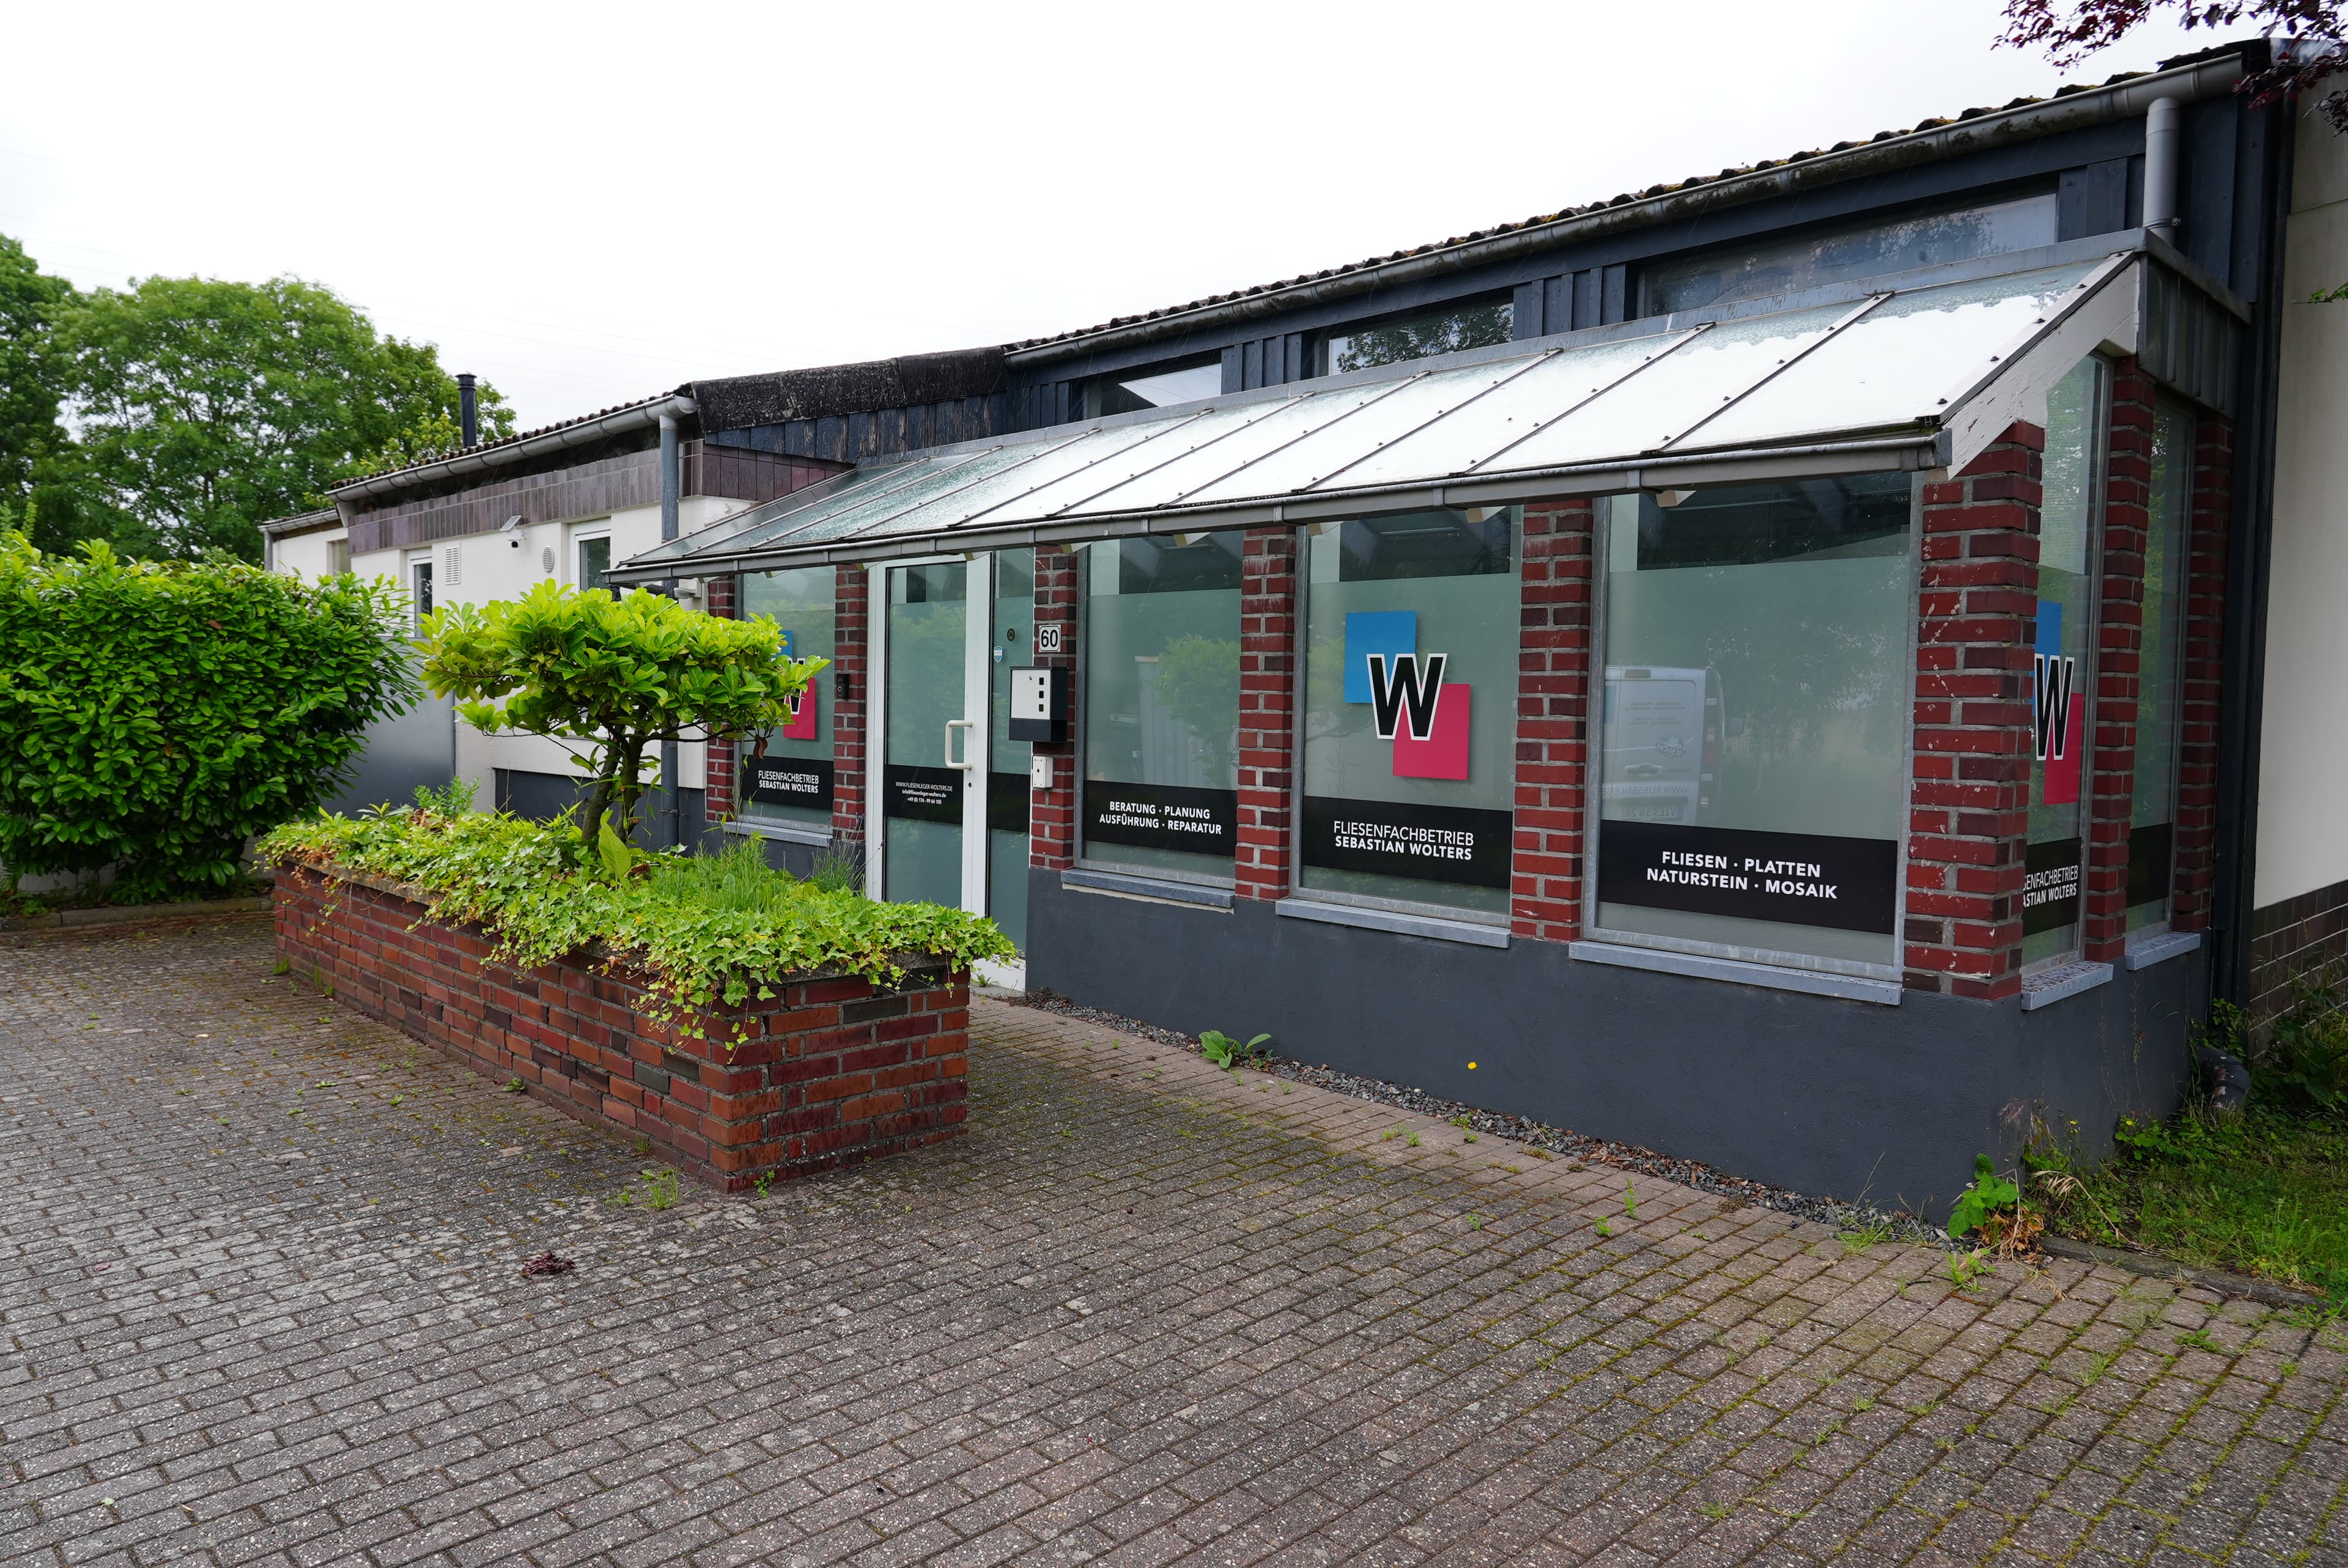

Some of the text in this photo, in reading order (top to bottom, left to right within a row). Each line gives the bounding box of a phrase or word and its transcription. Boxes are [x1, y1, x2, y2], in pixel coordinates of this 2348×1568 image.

[1041, 630, 1058, 647] 60
[1366, 653, 1447, 741] W
[2034, 653, 2075, 760] W
[758, 770, 819, 784] FLIESENFACHBETRIEB
[759, 780, 818, 793] SEBASTIAN WOLTERS
[1110, 801, 1210, 819] BERATUNG PLANUNG
[1099, 814, 1222, 834] AUSFÜHRUNG REPARATUR
[1334, 820, 1474, 846] FLIESENFACHBETRIEB
[1335, 836, 1472, 861] SEBASTIAN WOLTERS
[1662, 851, 1820, 878] FLIESEN PLATTEN
[1647, 868, 1838, 899] NATURSTEIN MOSAIK
[2048, 882, 2077, 902] WOLTERS
